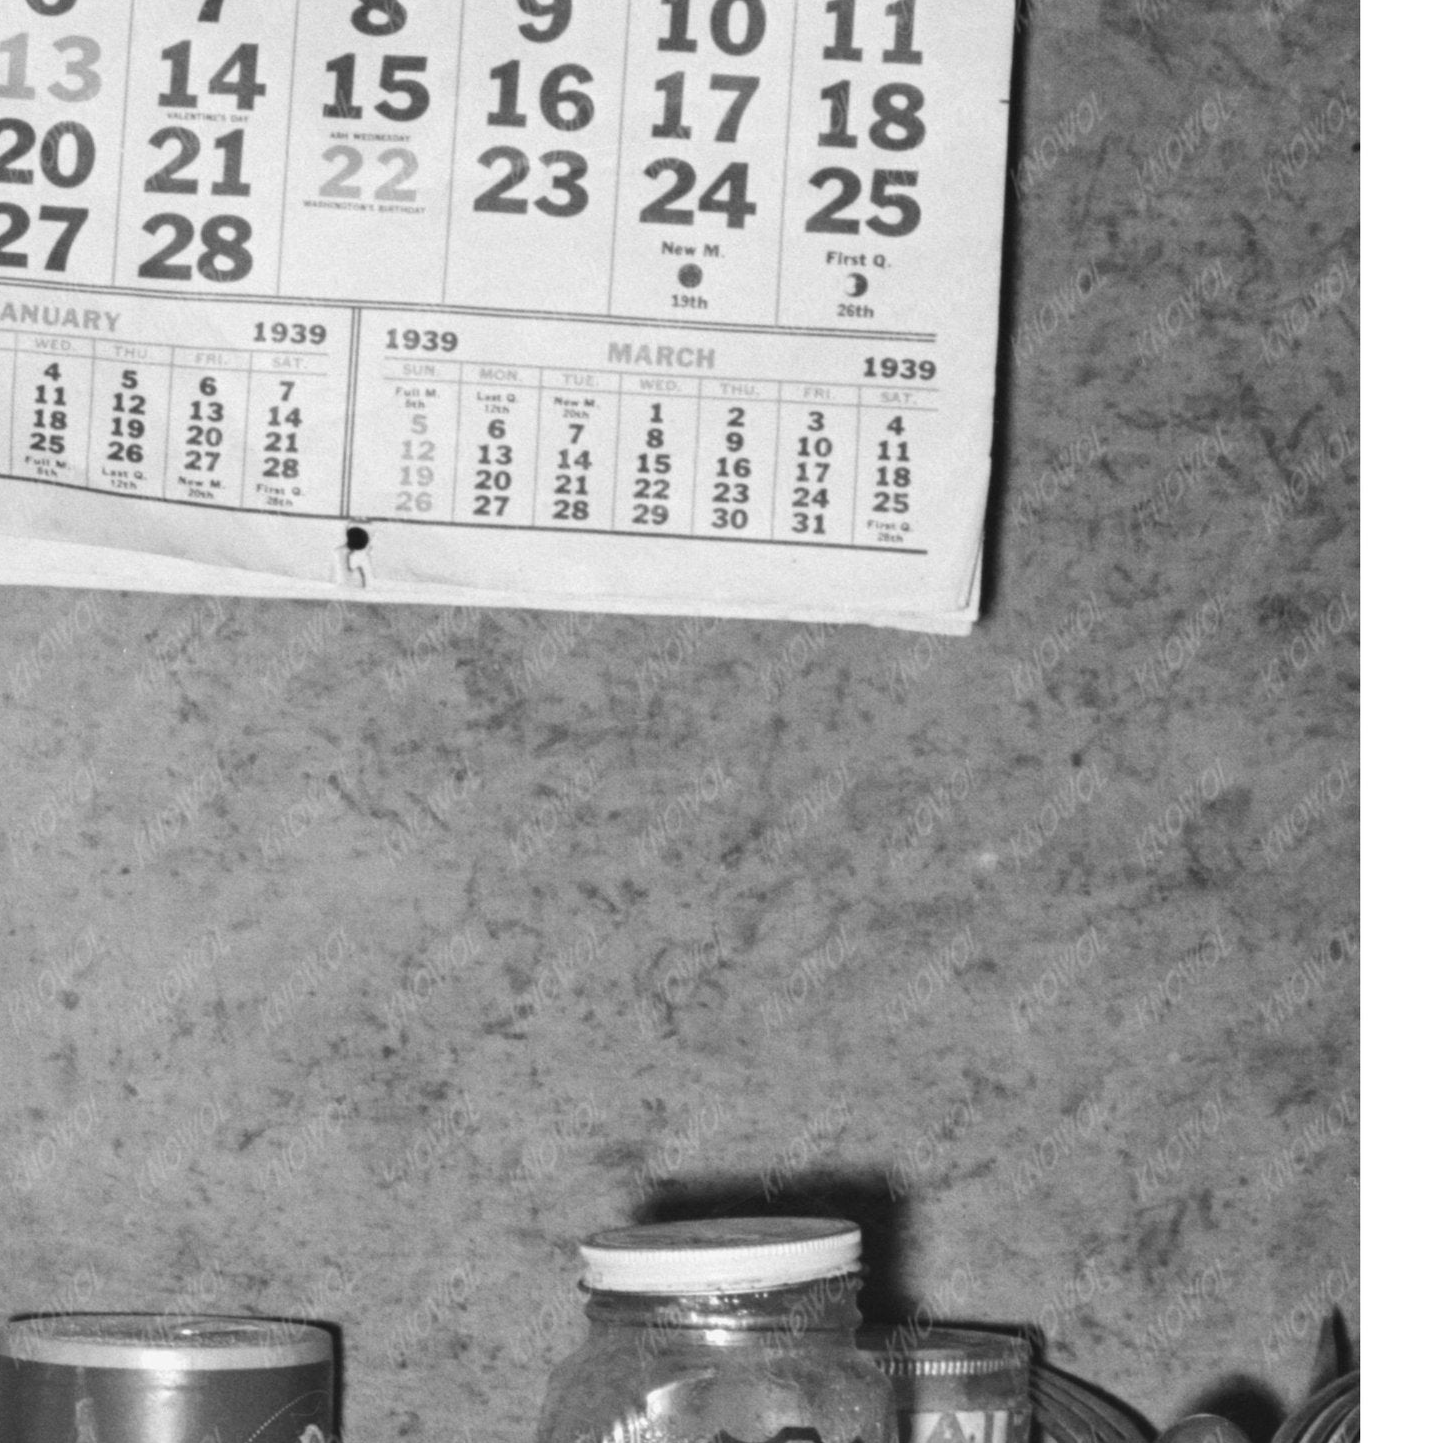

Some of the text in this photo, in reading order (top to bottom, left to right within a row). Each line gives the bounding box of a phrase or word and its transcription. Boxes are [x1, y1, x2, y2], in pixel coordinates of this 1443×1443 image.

[157, 39, 267, 111] 14
[322, 52, 431, 123] 15
[486, 59, 596, 132] 16
[651, 70, 761, 144] 17
[817, 79, 927, 152] 18
[143, 126, 252, 198] 21
[317, 144, 420, 203] 22
[472, 145, 590, 218] 23
[638, 157, 758, 230] 24
[804, 165, 923, 238] 25
[137, 211, 253, 281] 28
[660, 241, 725, 259] New M.
[824, 251, 893, 271] First Q.
[670, 293, 709, 310] 19th
[836, 303, 875, 320] 26th
[251, 322, 329, 345] 1939
[384, 327, 938, 382] 1939 MARCH 1939
